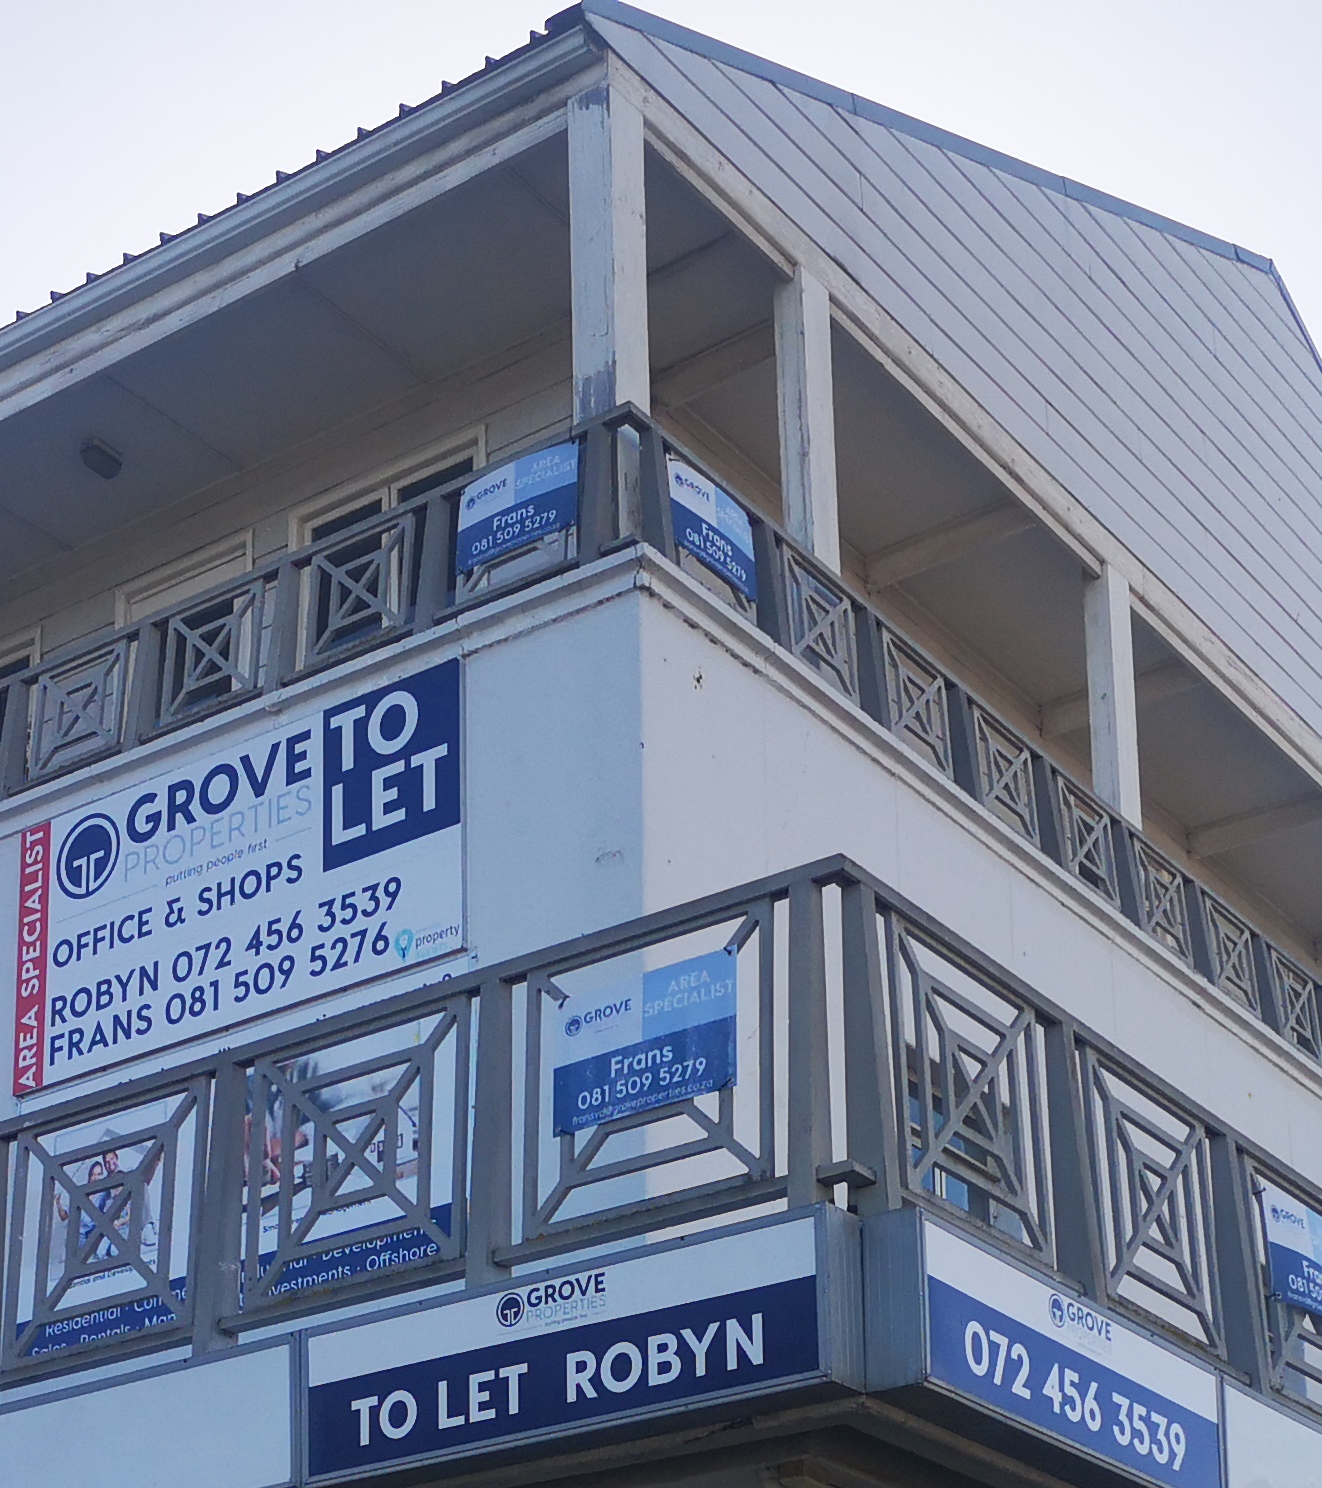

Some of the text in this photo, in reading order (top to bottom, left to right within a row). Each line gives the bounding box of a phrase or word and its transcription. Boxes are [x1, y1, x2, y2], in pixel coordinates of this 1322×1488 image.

[477, 479, 507, 500] GROVE
[472, 536, 493, 554] 081
[497, 525, 520, 543] 509
[524, 510, 556, 531] 5279
[493, 505, 534, 531] Frans
[686, 528, 704, 548] 081
[707, 541, 724, 562] 509
[702, 522, 732, 556] Frans
[330, 690, 419, 772] TO
[126, 729, 312, 844] GROVE
[331, 743, 448, 846] LET
[124, 784, 313, 883] PROPERTIES
[165, 838, 268, 887] putting people first
[53, 853, 303, 968] OFFICE & SHOPS
[49, 876, 402, 1028] ROBYN 072 456 3539
[415, 923, 460, 949] property
[17, 828, 45, 1088] AREA SPECIALIST
[49, 922, 390, 1067] FRANS 081 509 5276
[643, 979, 734, 1018] SPECIALIST
[667, 969, 710, 993] AREA
[583, 998, 632, 1024] GROVE
[610, 1045, 673, 1078] Frans
[577, 1057, 707, 1111] 081 509 5279
[366, 1242, 438, 1272] Offshore
[527, 1272, 606, 1308] GROVE
[1288, 1274, 1308, 1294] 081
[526, 1294, 606, 1323] PROPERTIES
[1066, 1302, 1112, 1341] GROVE
[351, 1312, 765, 1447] TO LET ROBYN
[964, 1319, 1032, 1402] 072
[1042, 1362, 1102, 1434] 456
[1111, 1391, 1188, 1473] 3539
